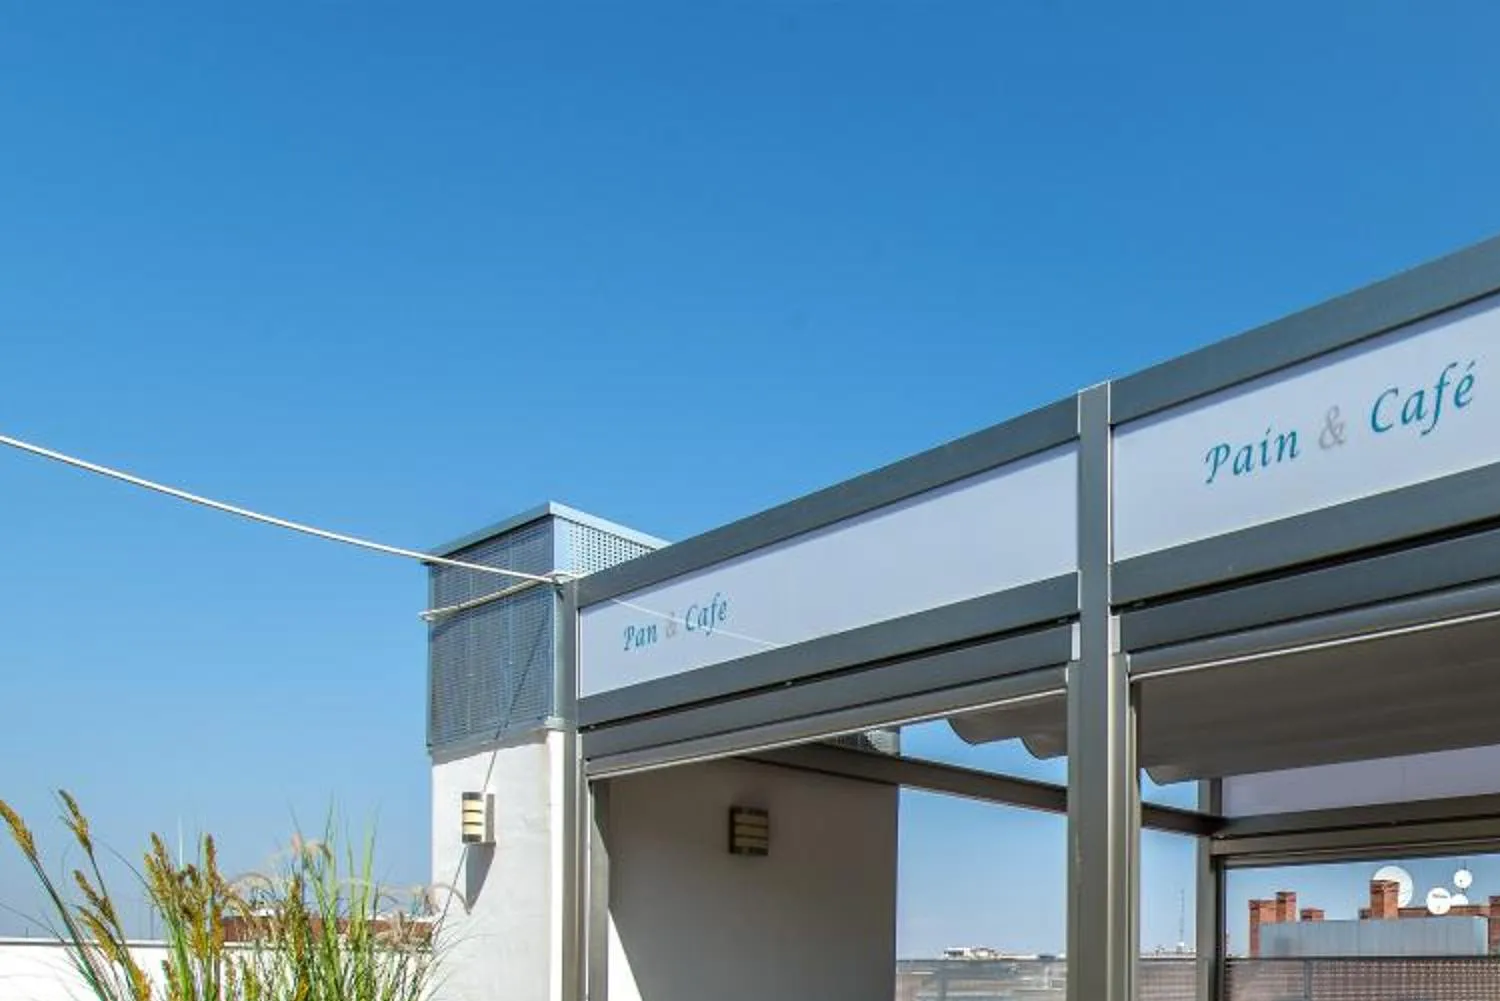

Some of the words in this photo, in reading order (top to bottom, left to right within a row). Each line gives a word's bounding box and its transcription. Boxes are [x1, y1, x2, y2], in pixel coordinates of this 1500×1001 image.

[1204, 427, 1300, 485] Pain
[1318, 405, 1346, 450] &
[1369, 359, 1476, 437] Café
[623, 623, 658, 652] Pan
